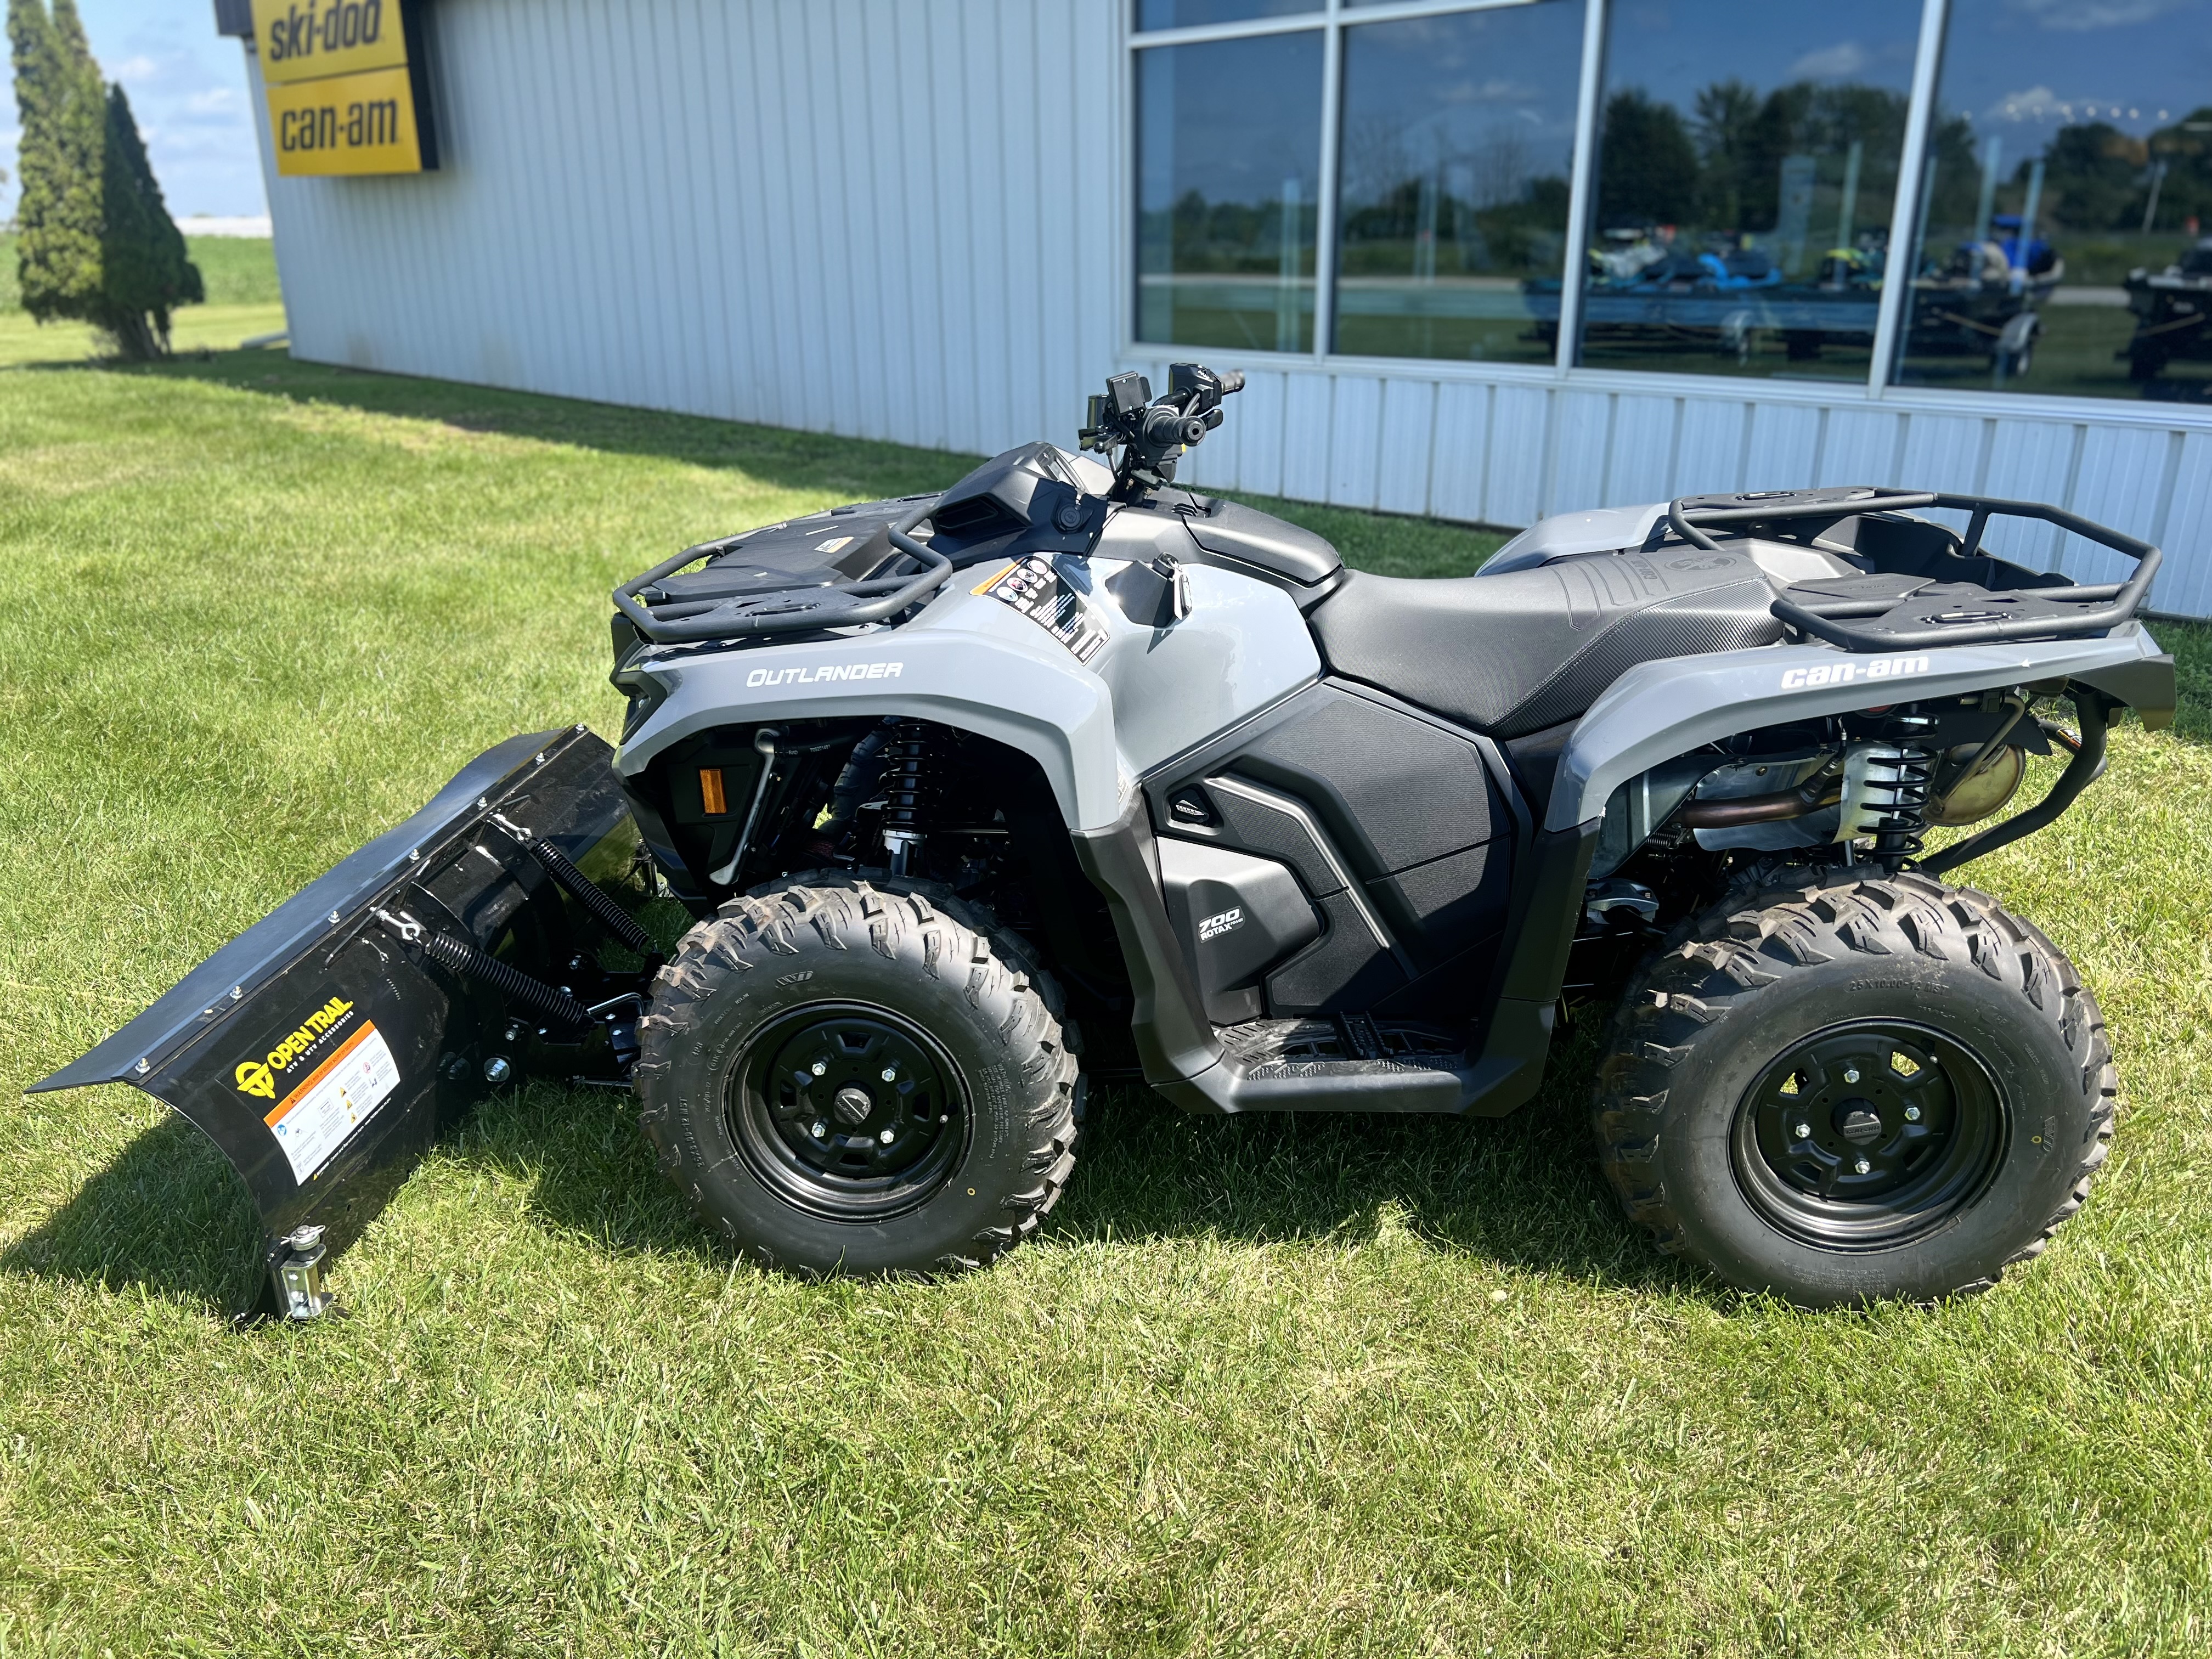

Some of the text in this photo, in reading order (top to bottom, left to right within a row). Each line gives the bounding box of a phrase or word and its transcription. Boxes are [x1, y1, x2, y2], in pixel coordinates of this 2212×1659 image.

[269, 0, 381, 62] ski-doo
[281, 99, 397, 153] can-am
[746, 662, 904, 687] OUTLANDER
[1781, 656, 1929, 689] can-am
[1199, 909, 1240, 933] 700
[1200, 923, 1232, 941] ROTAX
[267, 1025, 316, 1070] OPEN
[304, 997, 353, 1034] TRAIL
[286, 1062, 298, 1074] ATV
[304, 1044, 318, 1056] UTV
[318, 1011, 354, 1045] ACCESSORIES
